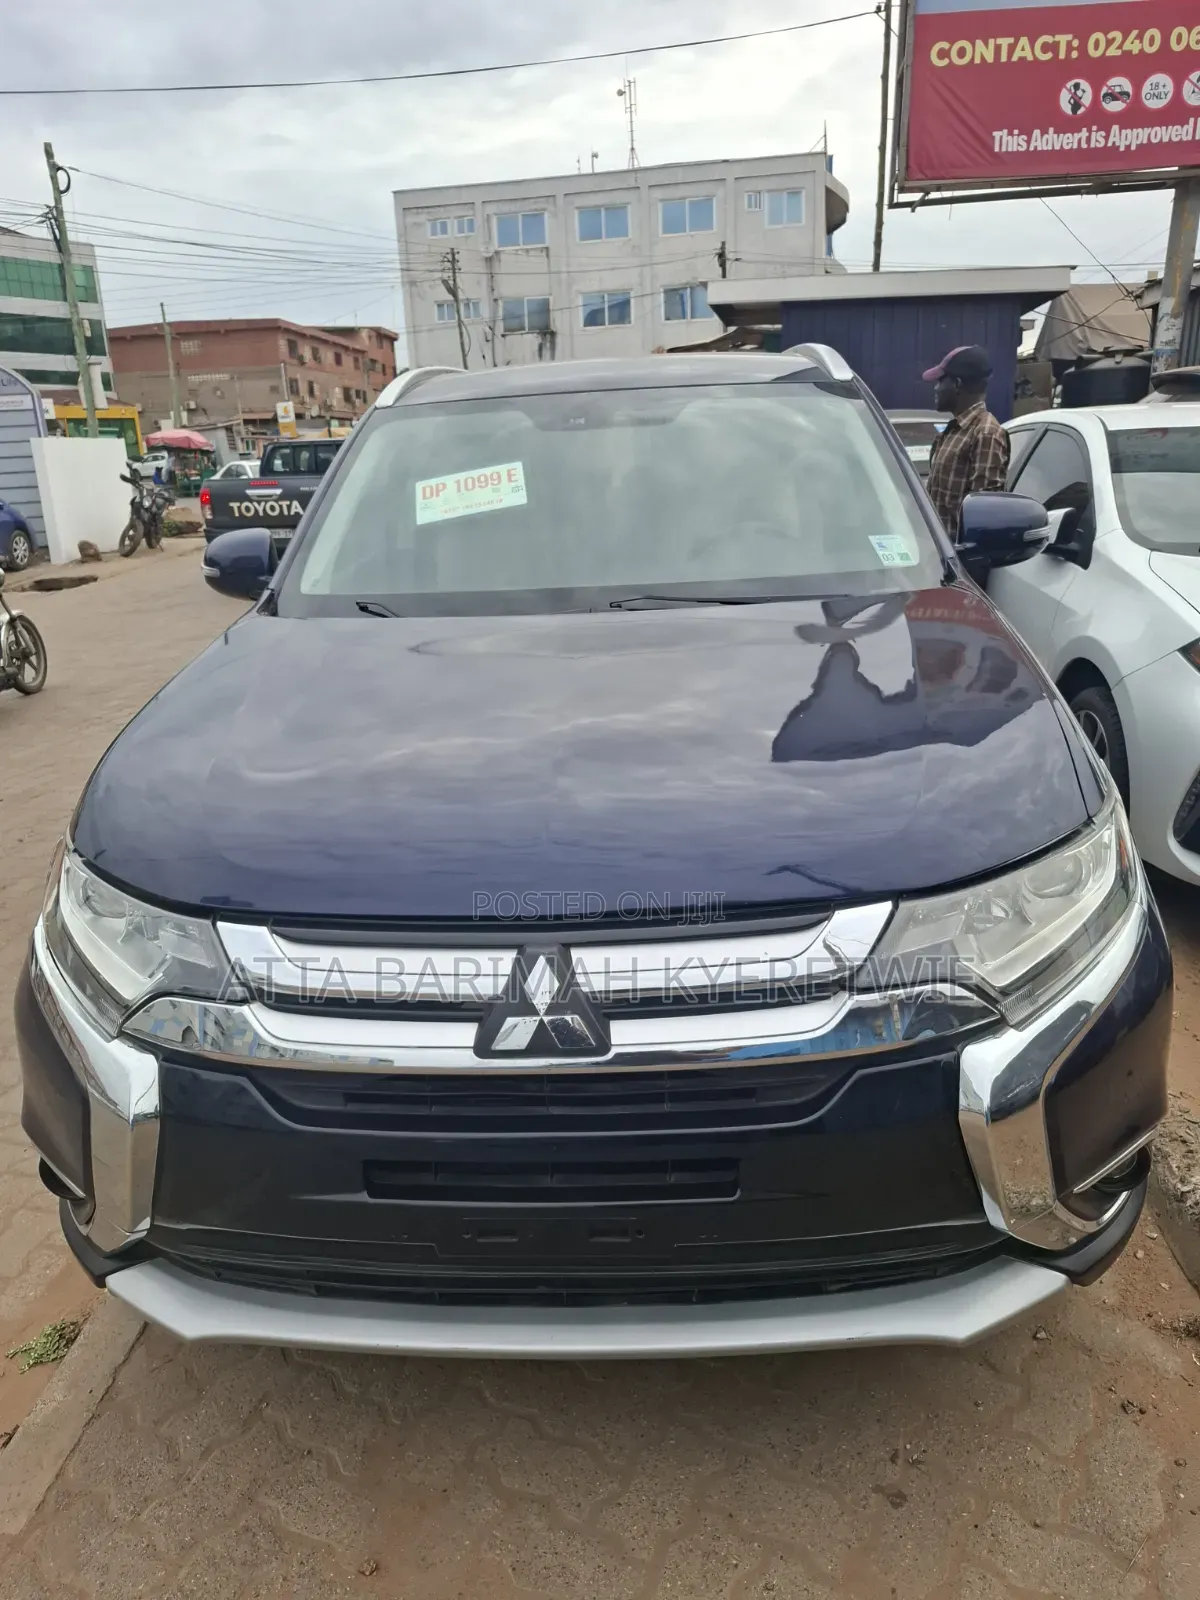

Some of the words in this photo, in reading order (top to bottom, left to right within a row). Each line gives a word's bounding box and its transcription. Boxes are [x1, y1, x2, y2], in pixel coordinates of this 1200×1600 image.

[930, 34, 1079, 67] CONTACT:
[1087, 27, 1162, 58] 0240
[1144, 91, 1170, 101] ONLY
[992, 128, 1028, 152] This
[1029, 127, 1088, 152] Advert
[1090, 126, 1105, 148] is
[1107, 118, 1193, 152] Approved
[421, 482, 447, 501] DP
[454, 471, 502, 493] 1099
[506, 467, 518, 484] E
[229, 500, 304, 517] TOYOTA
[881, 553, 895, 562] 03
